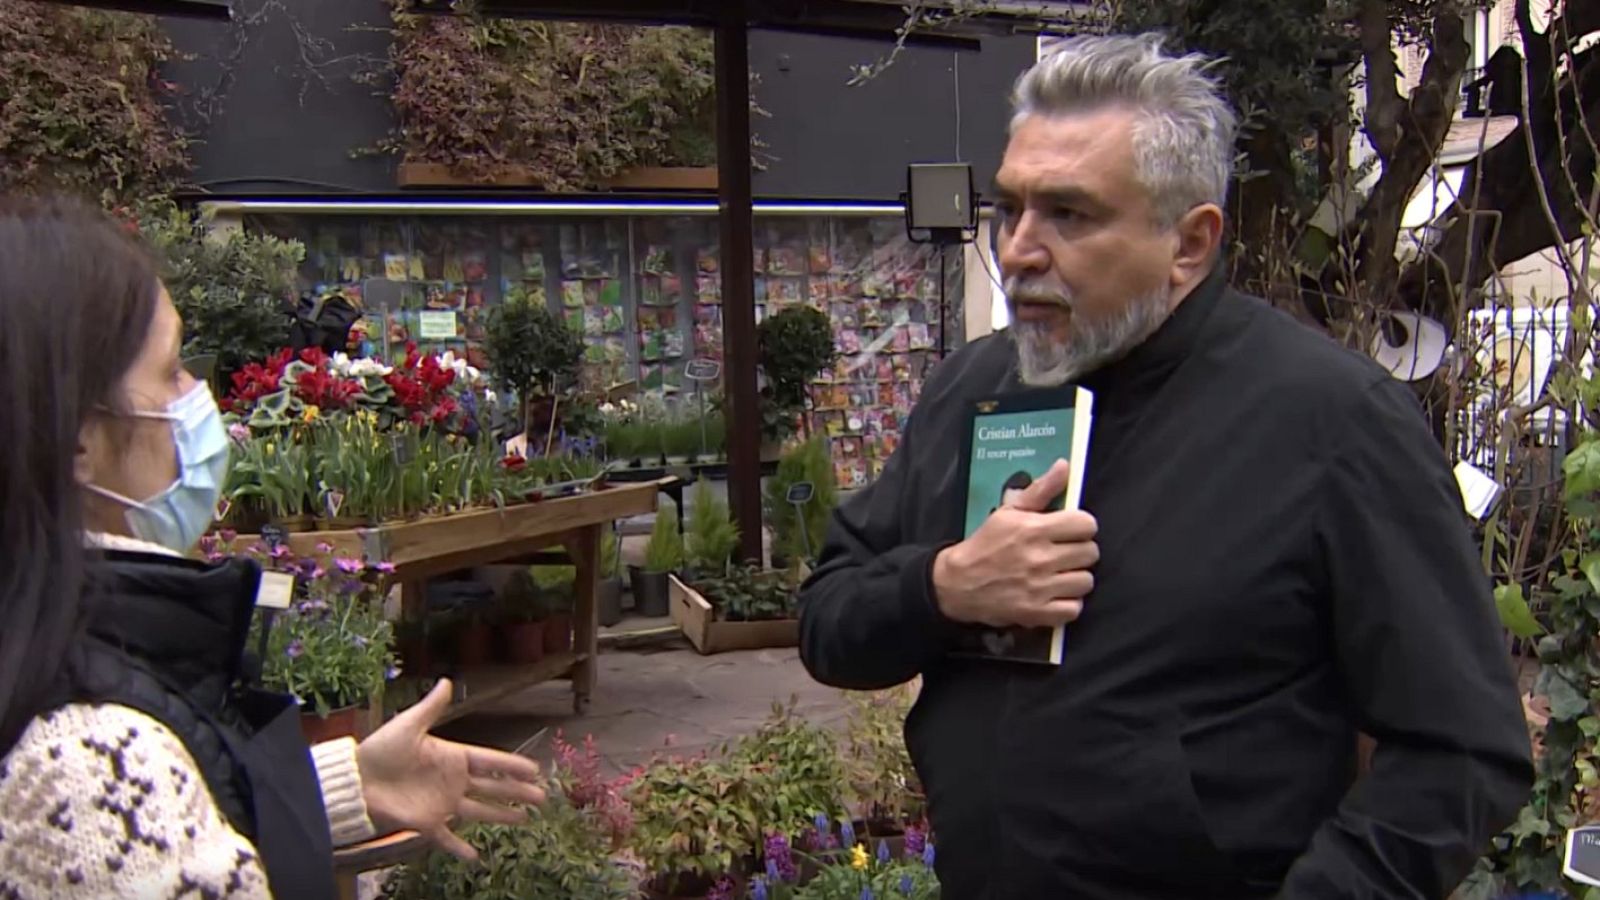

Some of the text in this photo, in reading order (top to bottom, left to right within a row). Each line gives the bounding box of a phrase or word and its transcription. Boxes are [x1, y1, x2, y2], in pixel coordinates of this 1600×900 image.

[979, 422, 1056, 441] Cristian Alarcón
[977, 448, 986, 459] El
